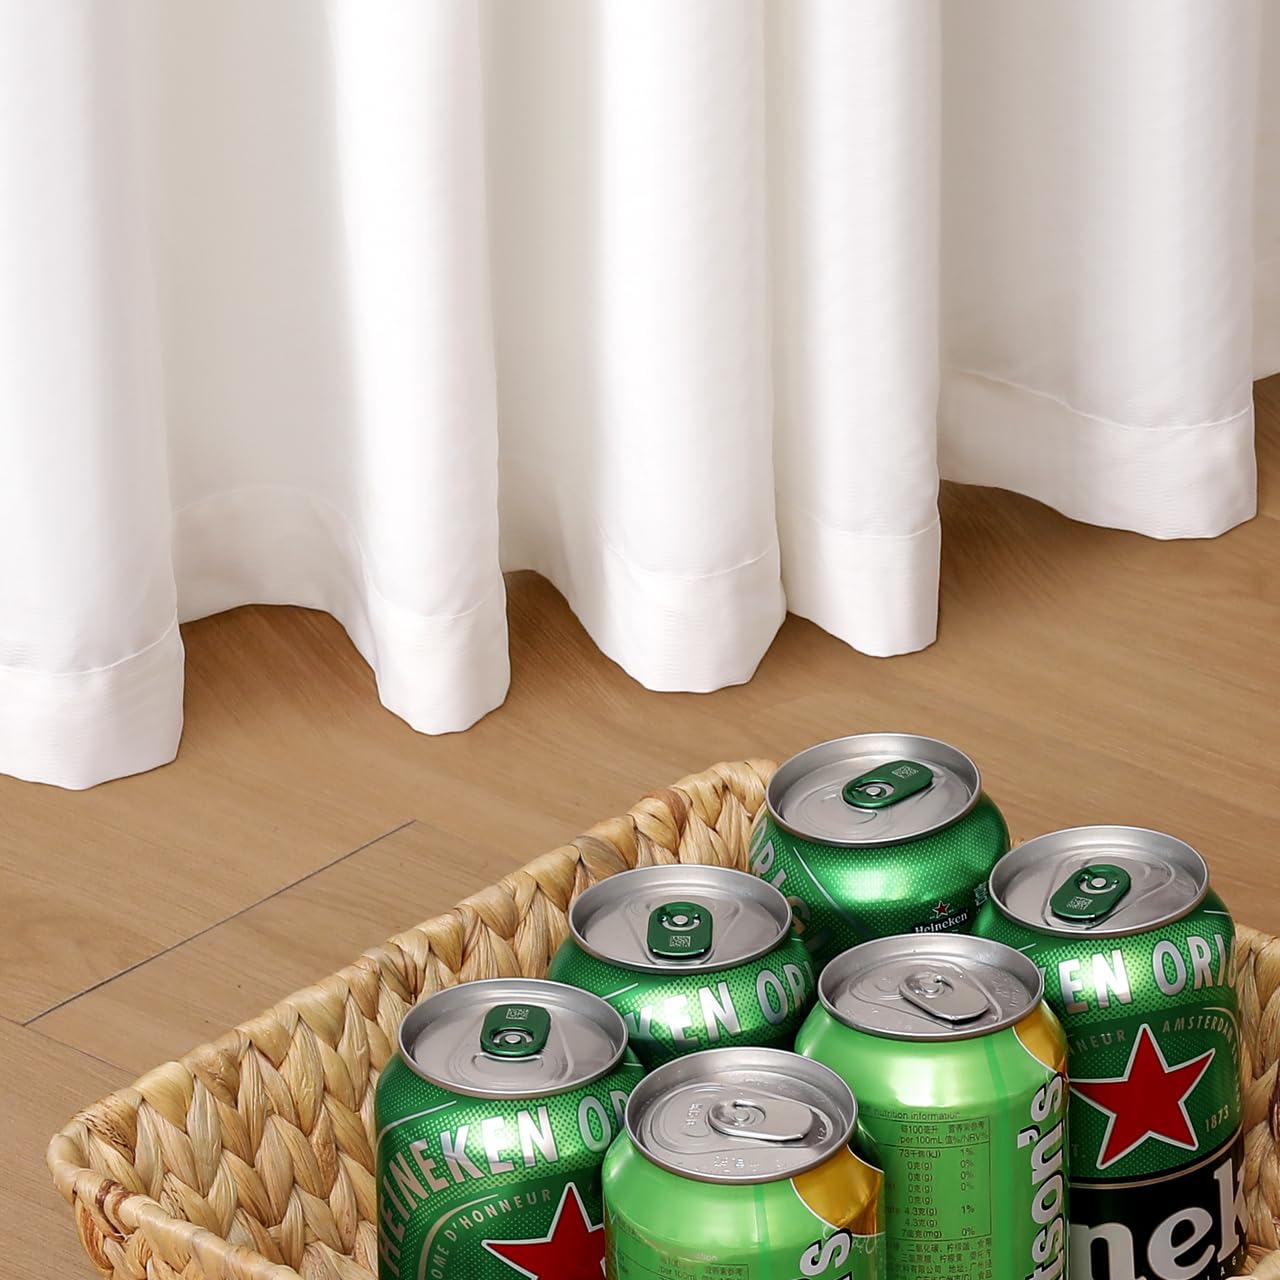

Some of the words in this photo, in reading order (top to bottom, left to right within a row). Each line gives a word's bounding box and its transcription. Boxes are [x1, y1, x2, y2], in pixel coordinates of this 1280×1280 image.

[1045, 949, 1132, 1015] EN
[1205, 1105, 1230, 1132] 1873
[444, 1190, 551, 1243] D'HONNEUR
